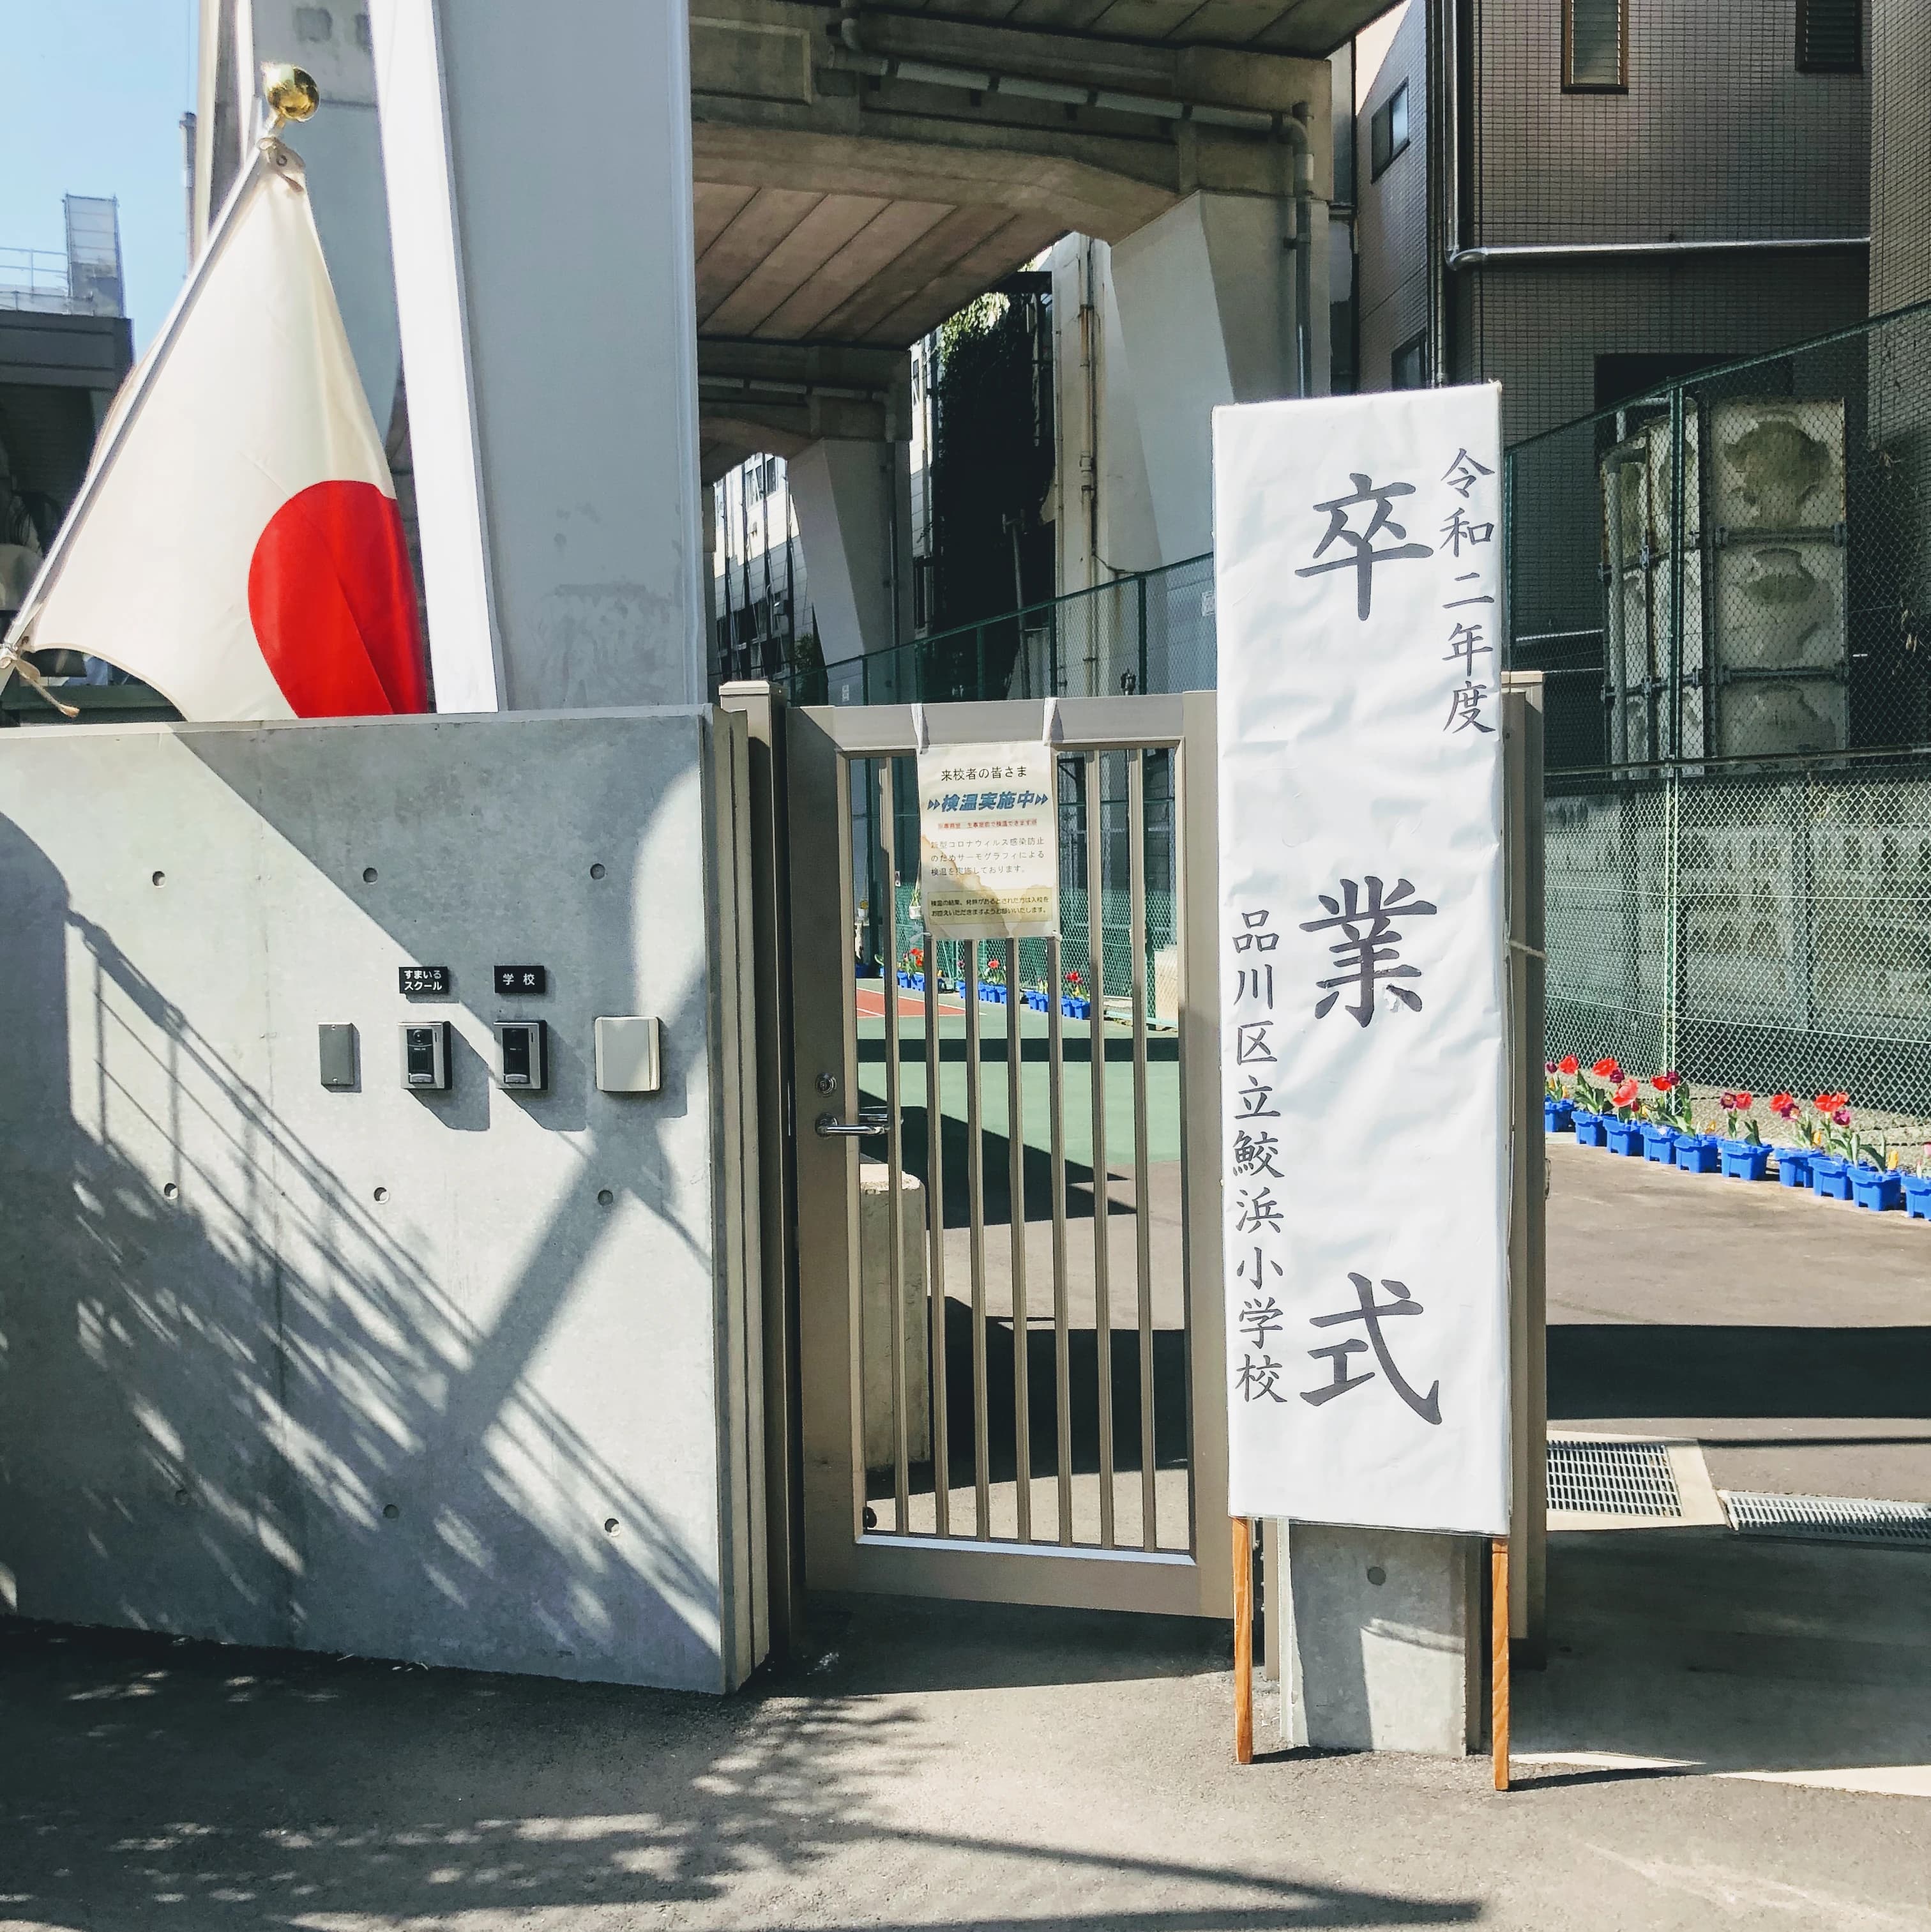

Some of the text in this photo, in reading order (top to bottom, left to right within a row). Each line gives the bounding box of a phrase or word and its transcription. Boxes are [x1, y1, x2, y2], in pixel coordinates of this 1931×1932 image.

[1440, 447, 1496, 733] 令和二年度
[941, 766, 1027, 782] 来校者の皆さま
[941, 790, 1034, 812] 検温実施中
[931, 850, 1045, 862] のためサーモグラフィによる
[1294, 473, 1443, 1426] 卒業式
[404, 970, 442, 980] すまいる
[503, 973, 535, 985] 学校
[404, 980, 443, 991] スクール
[1232, 909, 1289, 1403] 品川区立鮫浜小学校
